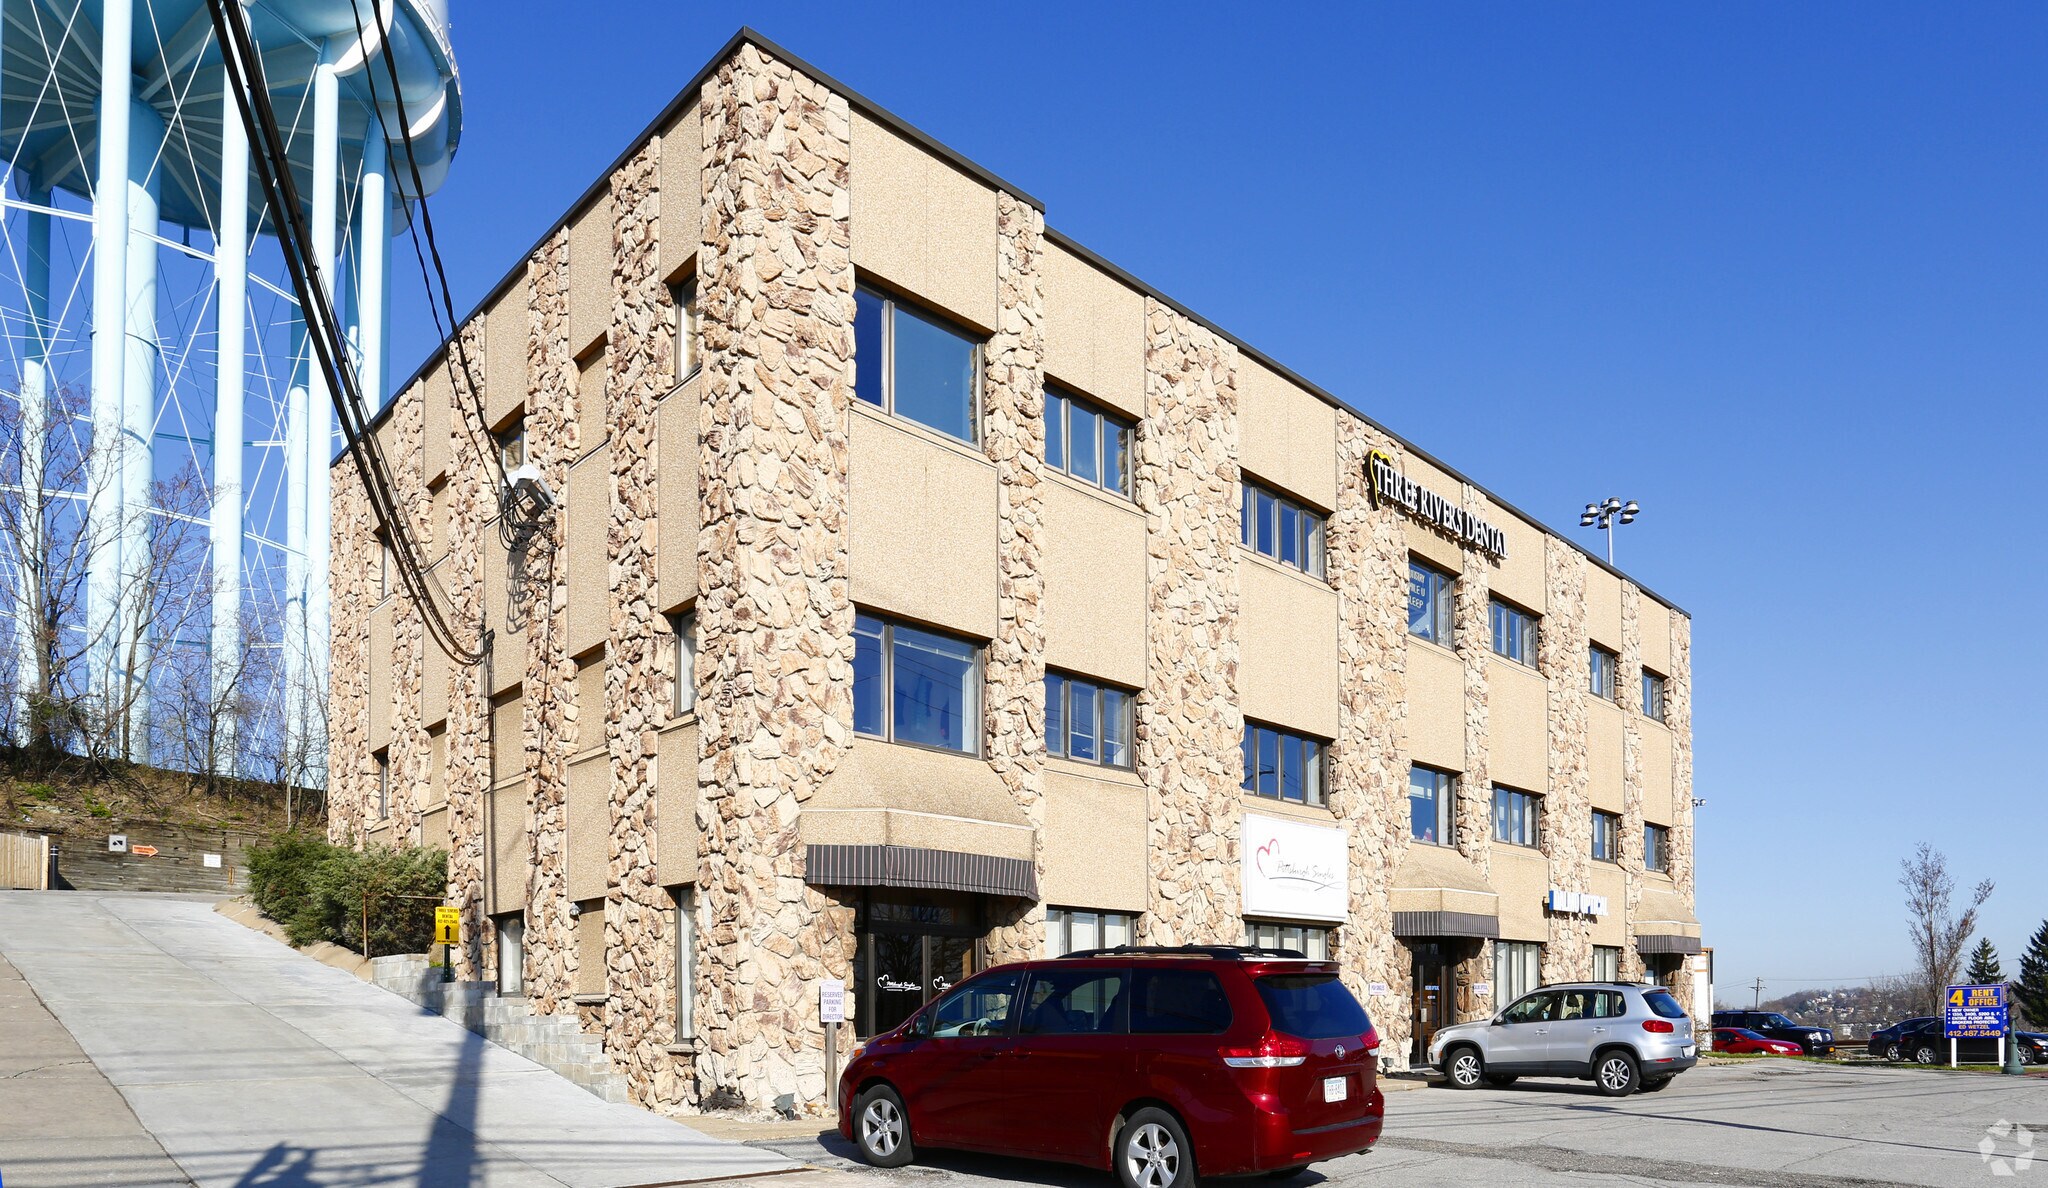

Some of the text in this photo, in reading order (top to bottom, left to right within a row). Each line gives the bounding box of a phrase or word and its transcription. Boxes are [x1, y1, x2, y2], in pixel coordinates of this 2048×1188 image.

[1374, 459, 1508, 560] THREE RIVERS DENTAL
[1949, 989, 1994, 1006] 4 RENT
